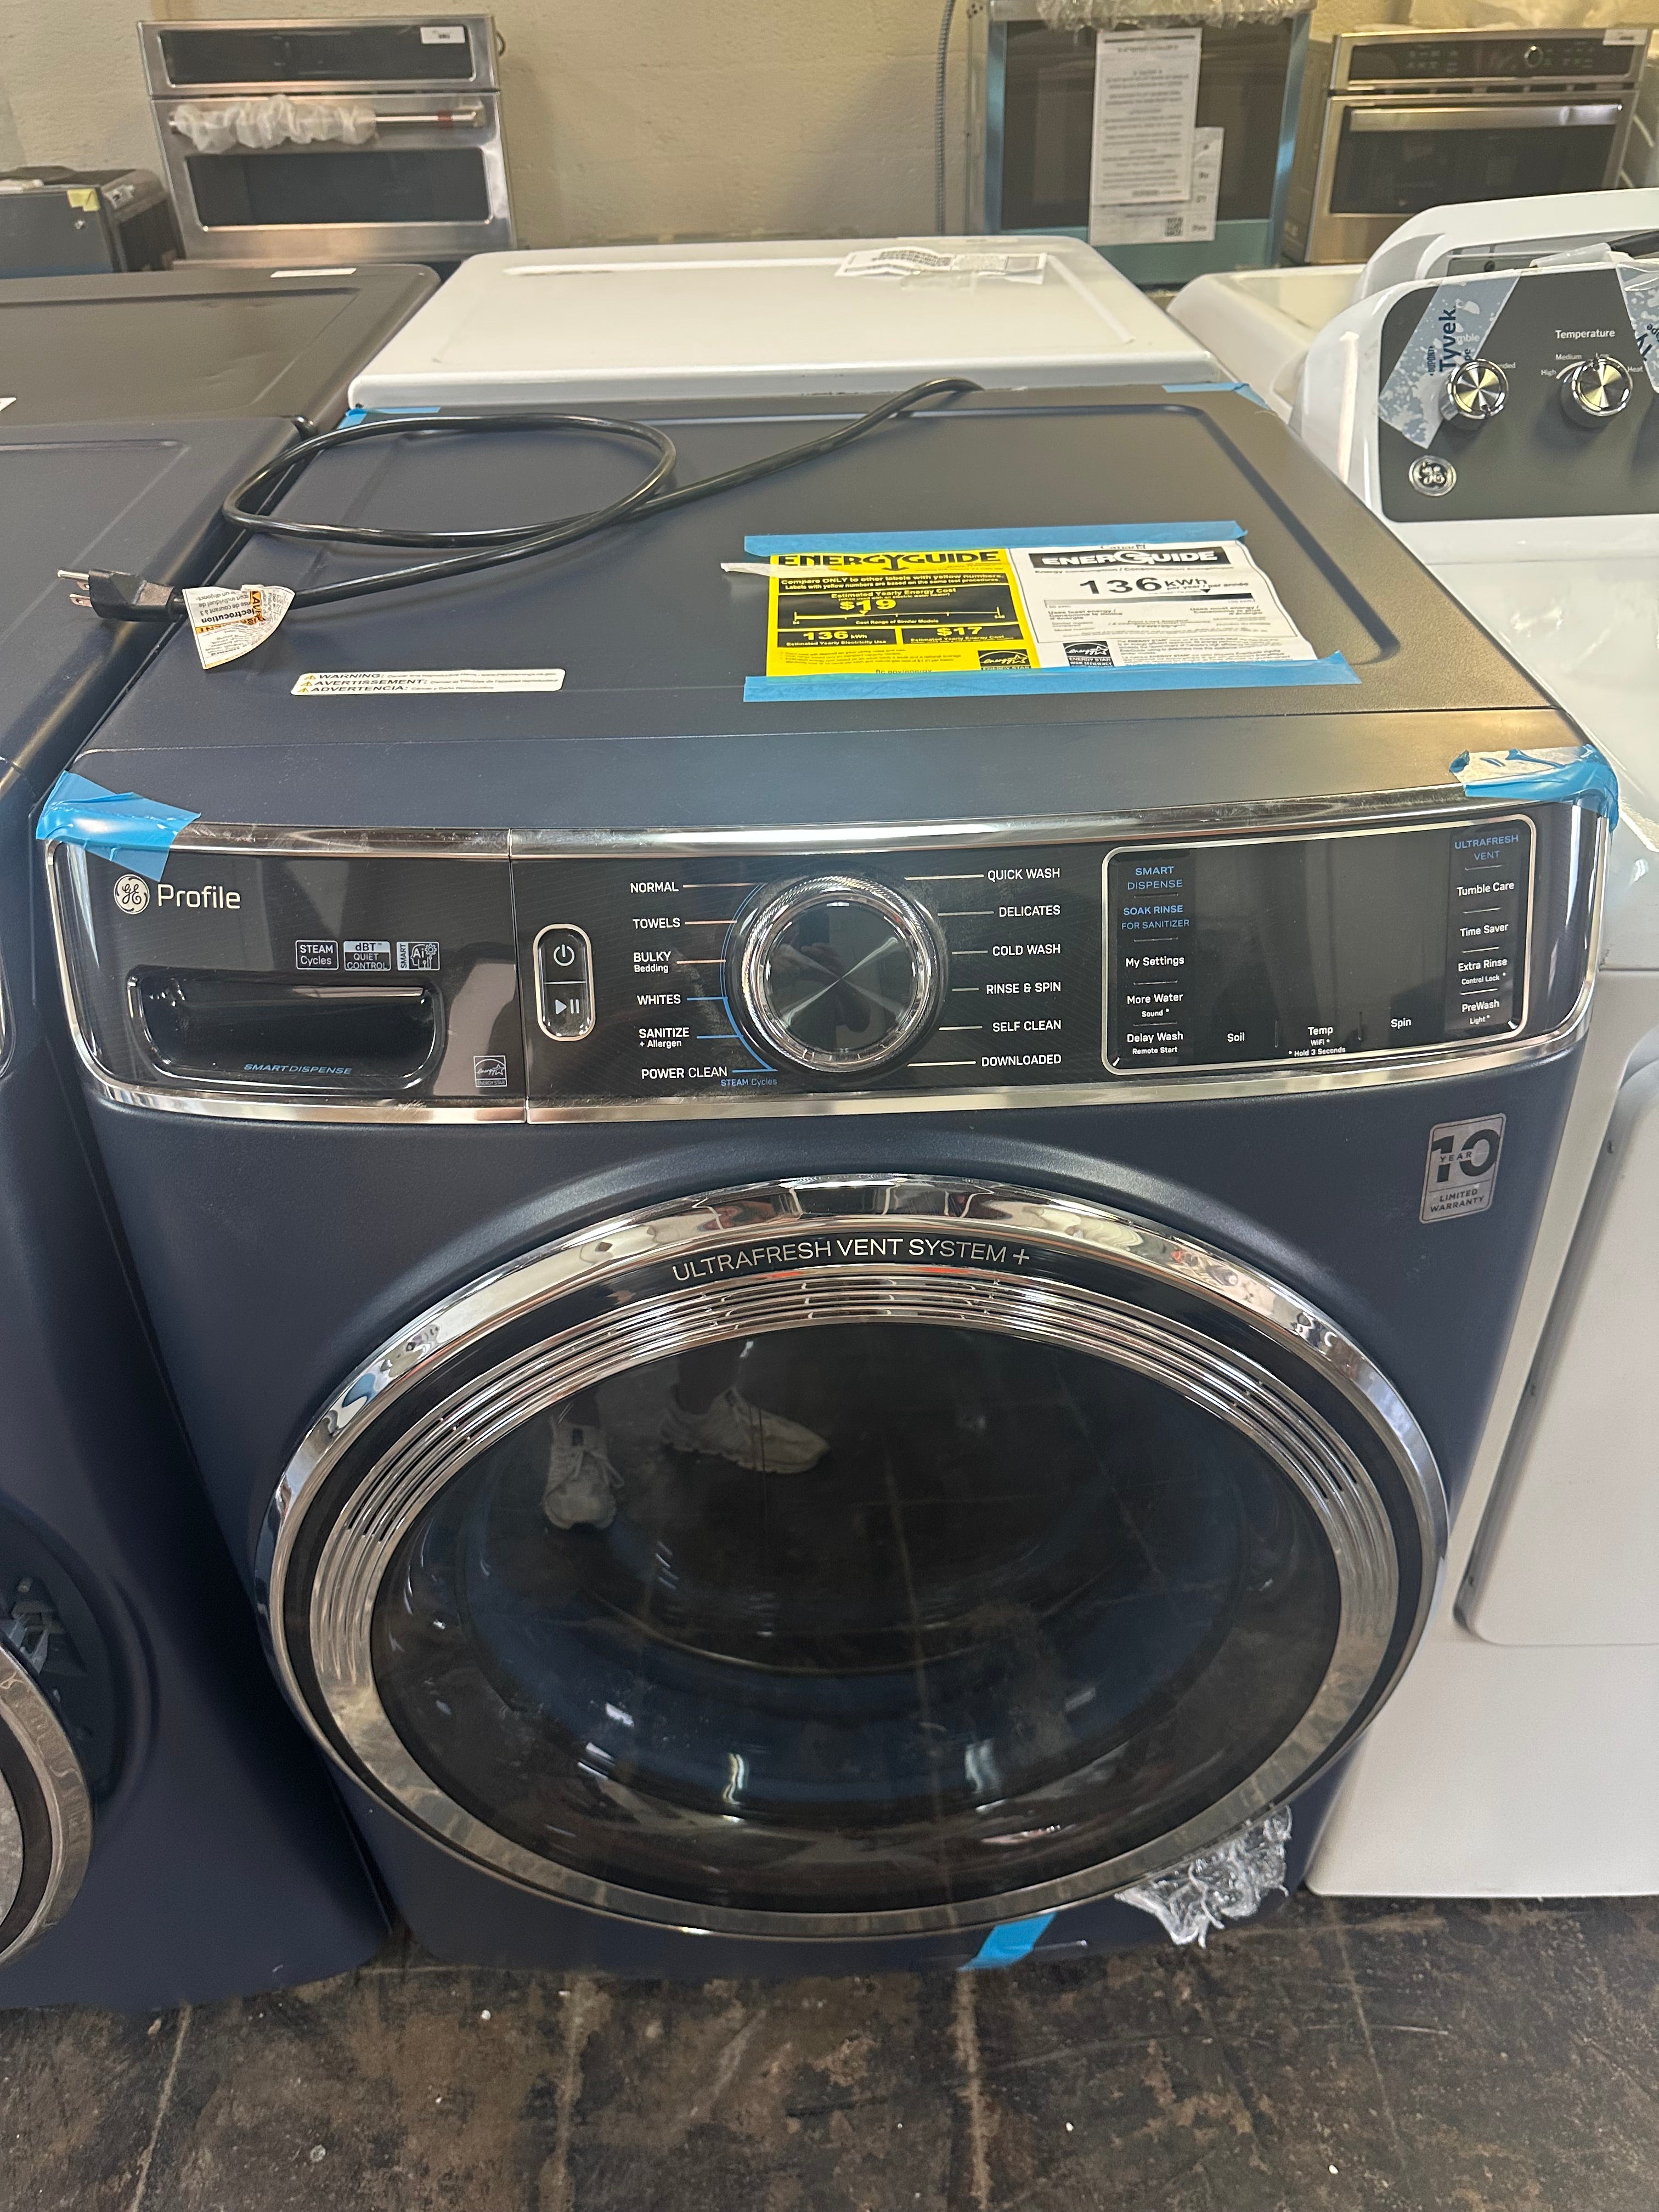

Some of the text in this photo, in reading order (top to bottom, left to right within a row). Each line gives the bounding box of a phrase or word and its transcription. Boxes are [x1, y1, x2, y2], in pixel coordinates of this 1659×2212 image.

[1438, 306, 1462, 373] Tyvek
[1555, 329, 1616, 340] Temperature
[779, 551, 1001, 571] ENERGYGUIDE
[1042, 550, 1217, 565] ENERGUIDE
[1080, 577, 1207, 594] 136 kWh
[840, 599, 896, 611] $19
[201, 608, 255, 623] lectrocution
[803, 631, 849, 640] 136
[936, 627, 983, 636] $17
[1454, 834, 1519, 850] ULTRAFRESH
[1474, 850, 1500, 861] VENT
[988, 868, 1060, 882] QUICK WASH
[1135, 866, 1175, 876] SMART
[630, 882, 679, 893] NORMAL
[1127, 879, 1183, 890] DISPENSE
[1457, 881, 1515, 896] Tumble Care
[157, 884, 240, 909] Profile
[998, 905, 1060, 917] DELICATES
[1123, 905, 1183, 916] SOAK RINSE
[633, 918, 681, 929] TOWELS
[1121, 919, 1190, 930] FOR SANITIZER
[1460, 924, 1509, 937] Time Saver
[300, 944, 334, 953] STEAM
[992, 944, 1061, 956] COLD WASH
[301, 956, 332, 967] Cycles
[633, 951, 671, 962] BULKY
[1126, 956, 1185, 968] My Settings
[347, 962, 388, 970] CONTROL
[634, 964, 669, 974] Bedding
[1458, 958, 1508, 972] Extra Rinse
[1462, 974, 1500, 985] Control Lock
[986, 981, 1062, 995] RINSE & SPIN
[636, 994, 681, 1006] WHITES
[1127, 993, 1183, 1005] More Water
[1462, 999, 1500, 1013] PreWash
[1141, 1009, 1164, 1018] Sound
[992, 1019, 1062, 1032] SELF CLEAN
[1391, 1018, 1412, 1029] Spin
[1470, 1016, 1486, 1025] Light
[639, 1027, 690, 1039] SANITIZE
[1307, 1025, 1334, 1036] Temp
[1127, 1031, 1183, 1043] Delay Wash
[1227, 1032, 1245, 1042] Soil
[647, 1040, 682, 1049] Allergen
[1132, 1046, 1178, 1055] Remote Start
[1294, 1049, 1309, 1057] Hold
[1317, 1047, 1346, 1055] Seconds
[981, 1054, 1062, 1067] DOWNLOADED
[641, 1066, 727, 1080] POWER CLEAN
[721, 1078, 777, 1088] STEAM Cycles
[1431, 1128, 1500, 1183] 10
[1440, 1151, 1472, 1163] YEAR
[1440, 1189, 1478, 1202] LIMITED
[1430, 1195, 1484, 1212] WARRANTY
[673, 1240, 831, 1281] ULTRAFRESH
[837, 1238, 904, 1256] VENT
[909, 1238, 1007, 1263] SYSTEM
